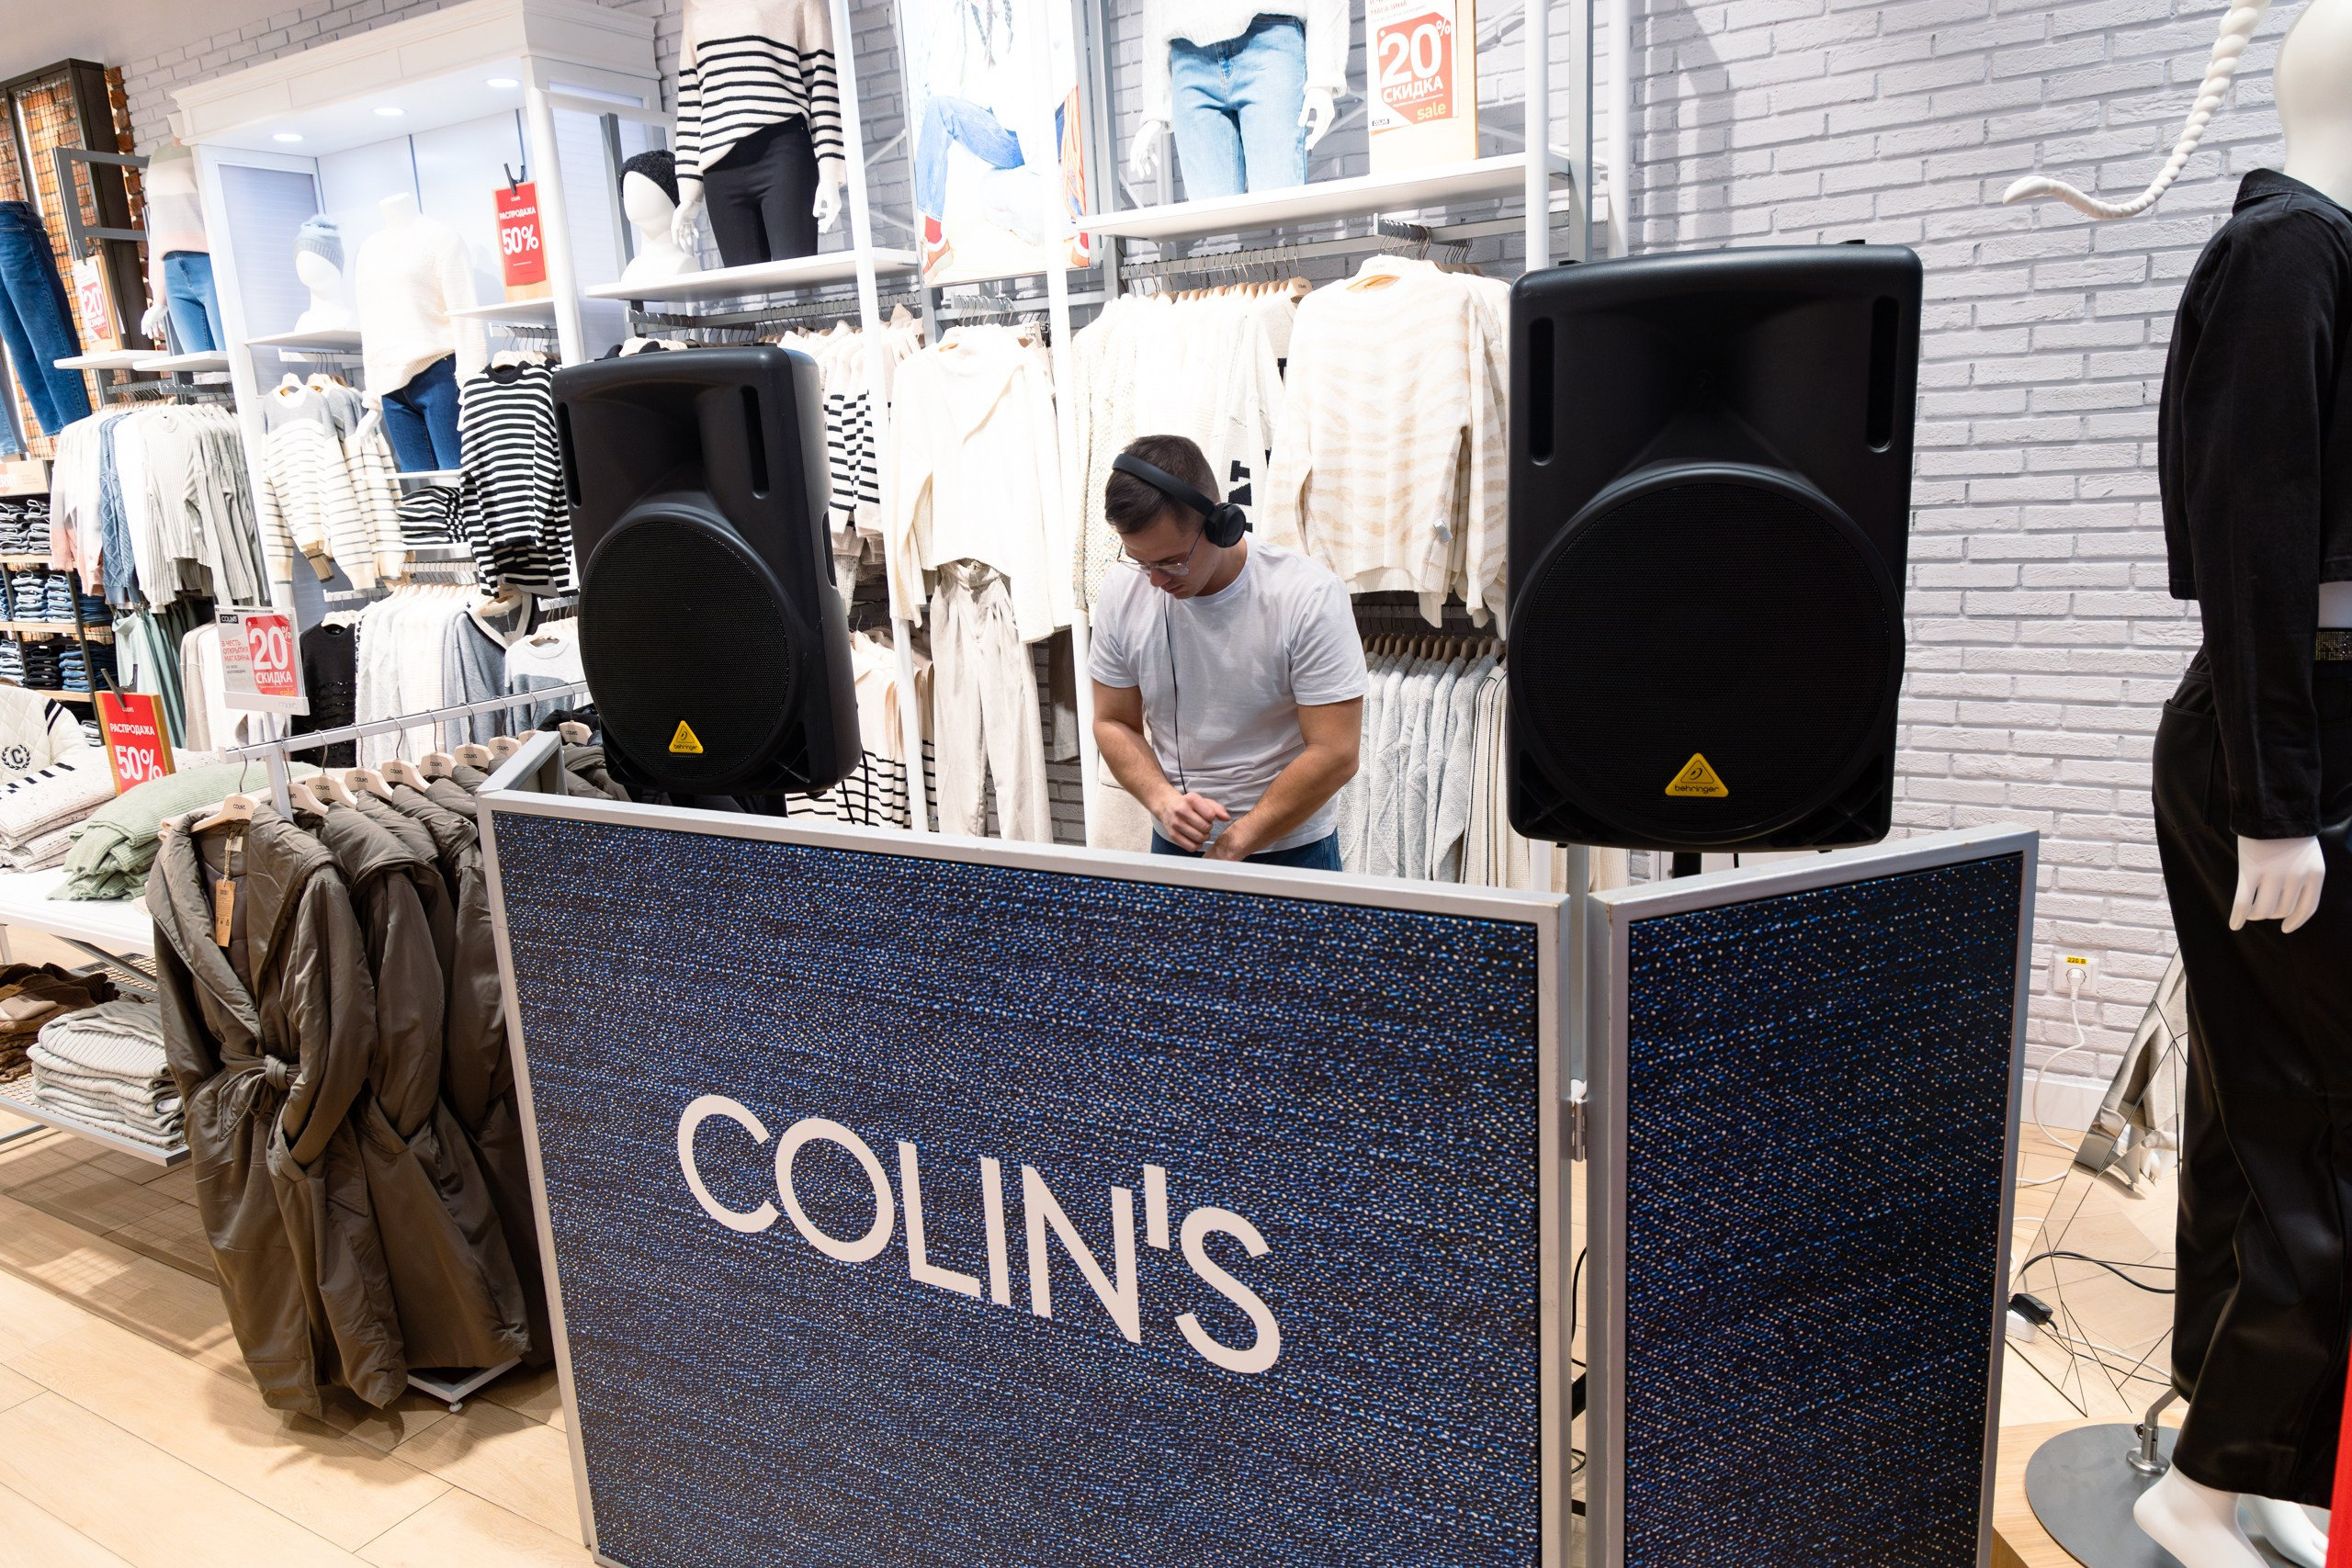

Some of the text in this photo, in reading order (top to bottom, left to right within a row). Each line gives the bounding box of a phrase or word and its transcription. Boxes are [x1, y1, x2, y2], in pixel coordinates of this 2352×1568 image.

[1379, 18, 1451, 88] 20%
[1384, 76, 1443, 103] СКИДКА
[1417, 101, 1447, 121] sale
[499, 207, 537, 220] РАСПРОДАЖА
[502, 224, 539, 255] 50%
[250, 626, 291, 670] 20%
[256, 671, 292, 685] СКИДКА
[109, 723, 155, 736] РАСПРОДАЖА
[11, 749, 24, 764] C
[115, 745, 164, 782] 50%
[1674, 784, 1720, 795] behringer
[677, 1094, 1281, 1374] COLIN'S
